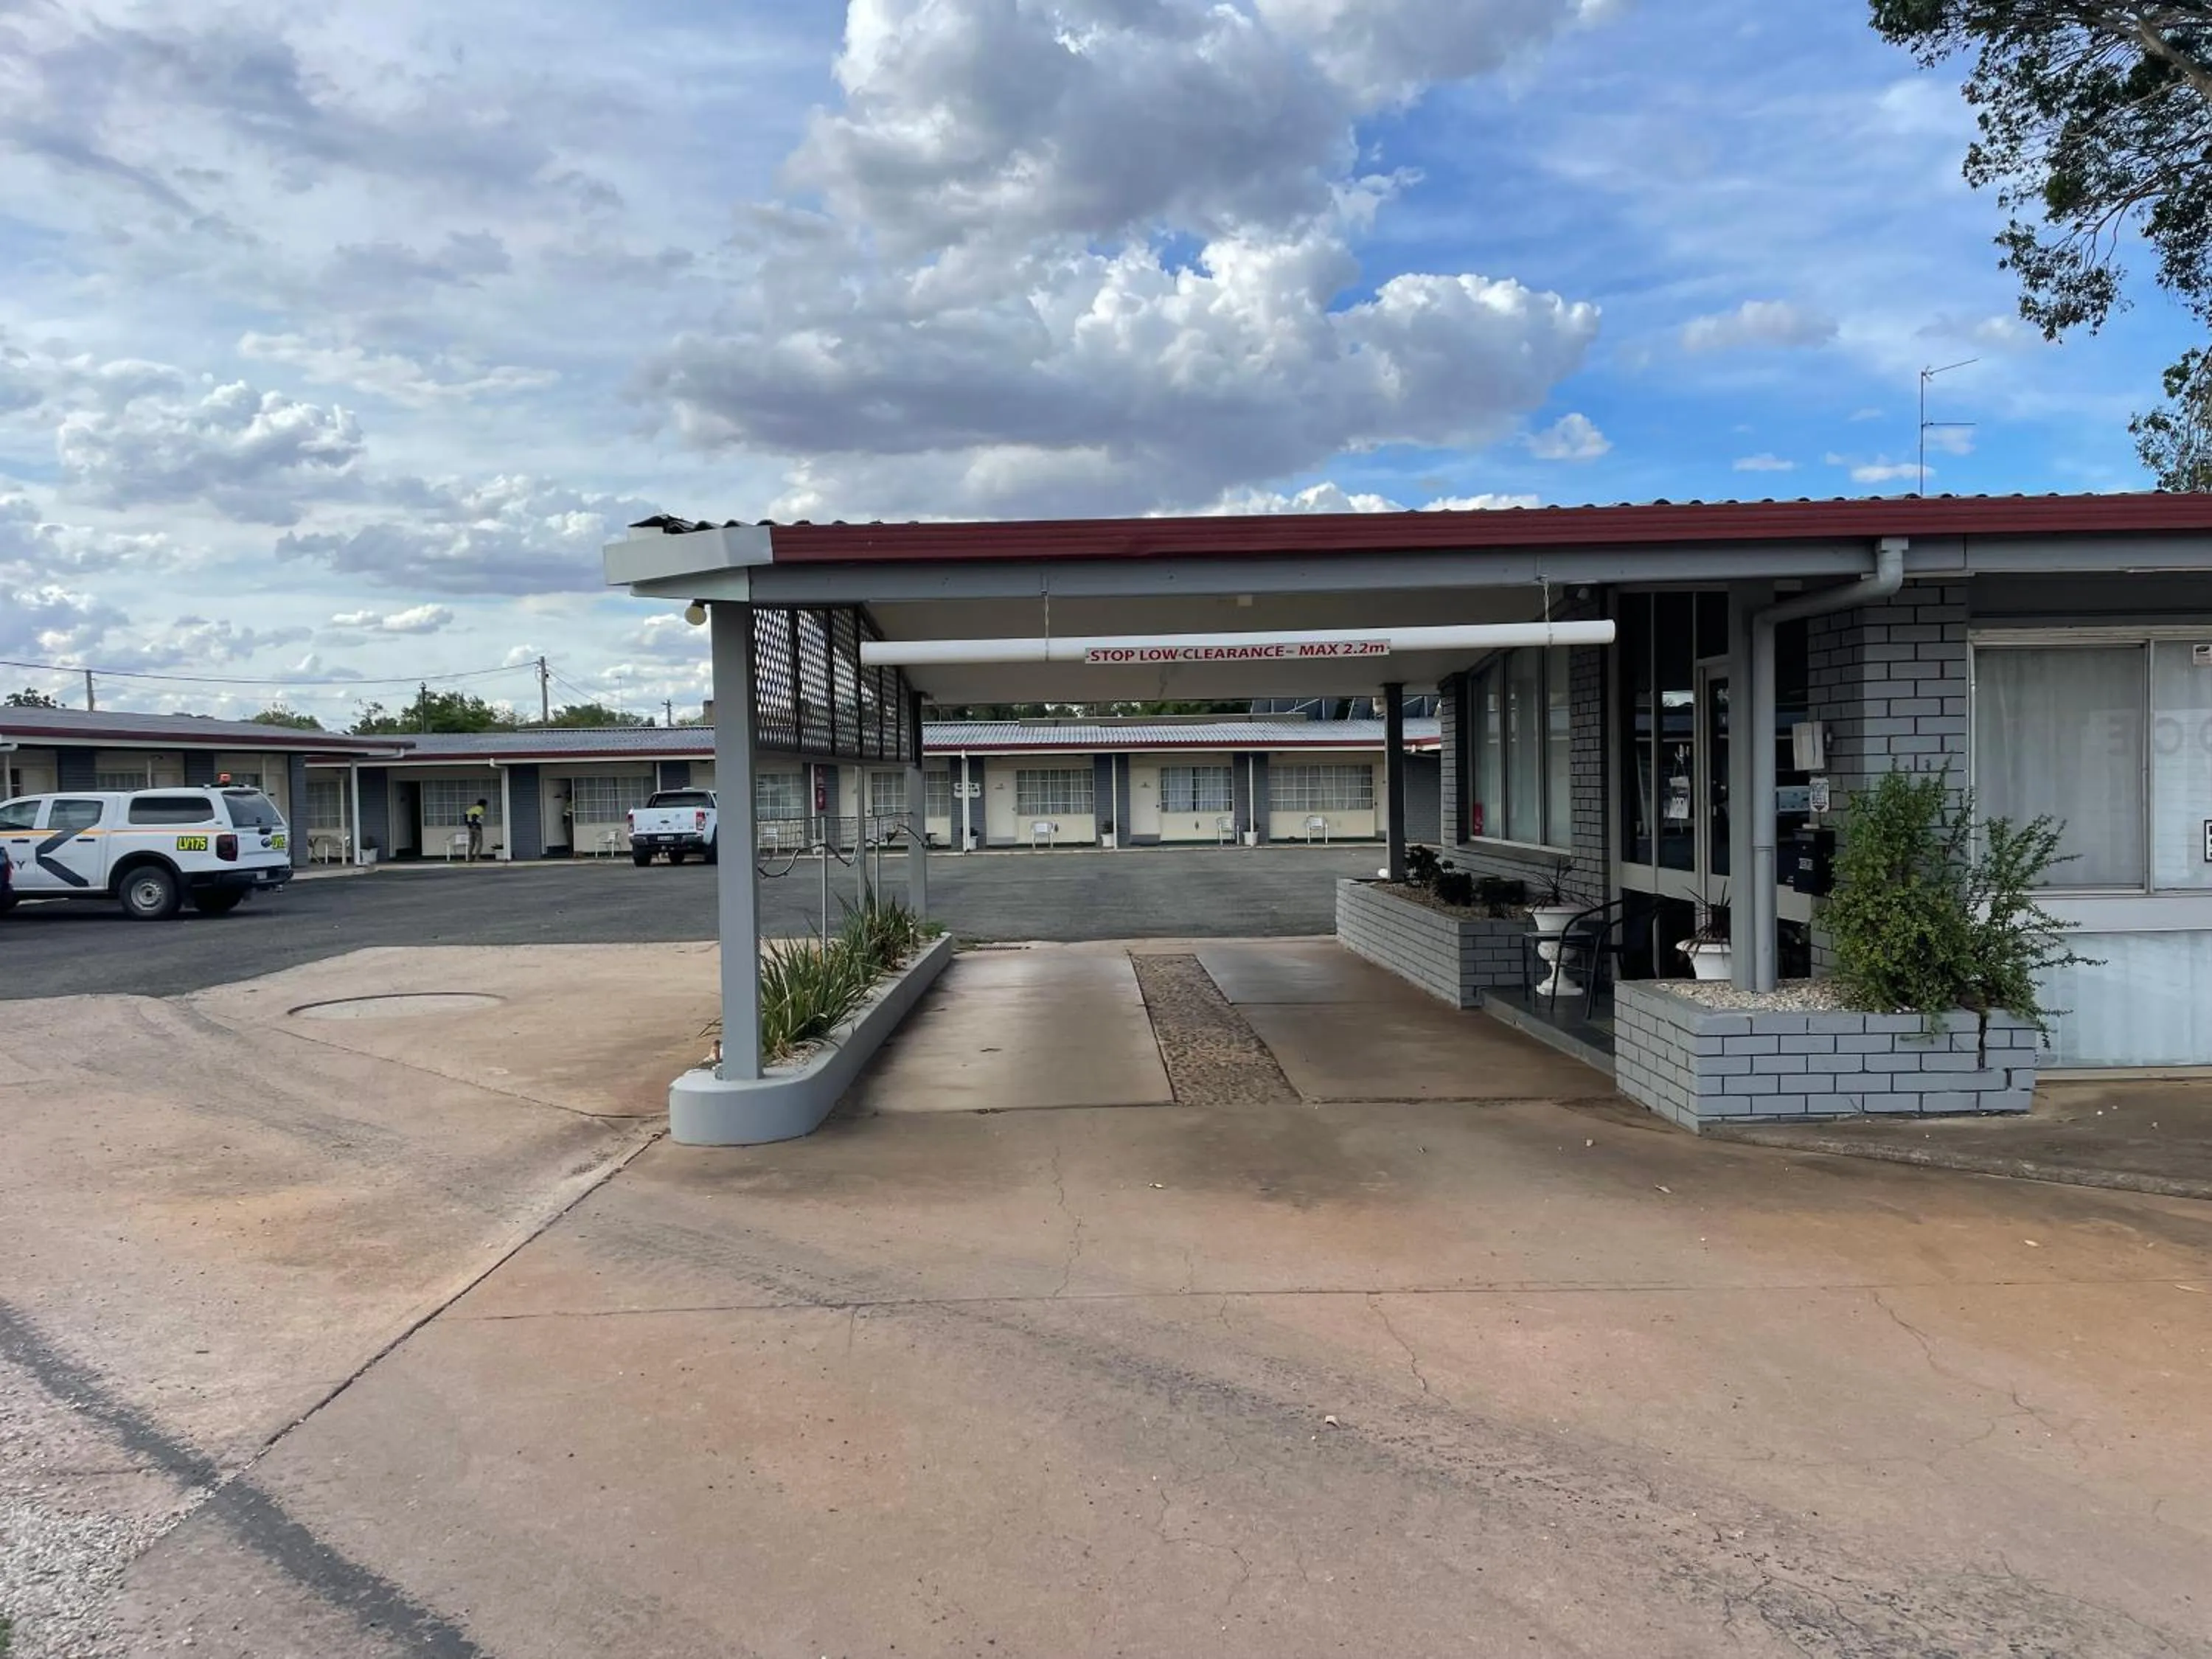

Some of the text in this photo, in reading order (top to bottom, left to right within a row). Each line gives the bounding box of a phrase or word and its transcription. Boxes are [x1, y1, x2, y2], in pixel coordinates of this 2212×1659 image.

[1091, 650, 1135, 661] STOP
[1139, 648, 1179, 661] LOW
[1299, 644, 1338, 655] MAX
[1343, 642, 1385, 654] 2.2m
[178, 837, 206, 850] LV175
